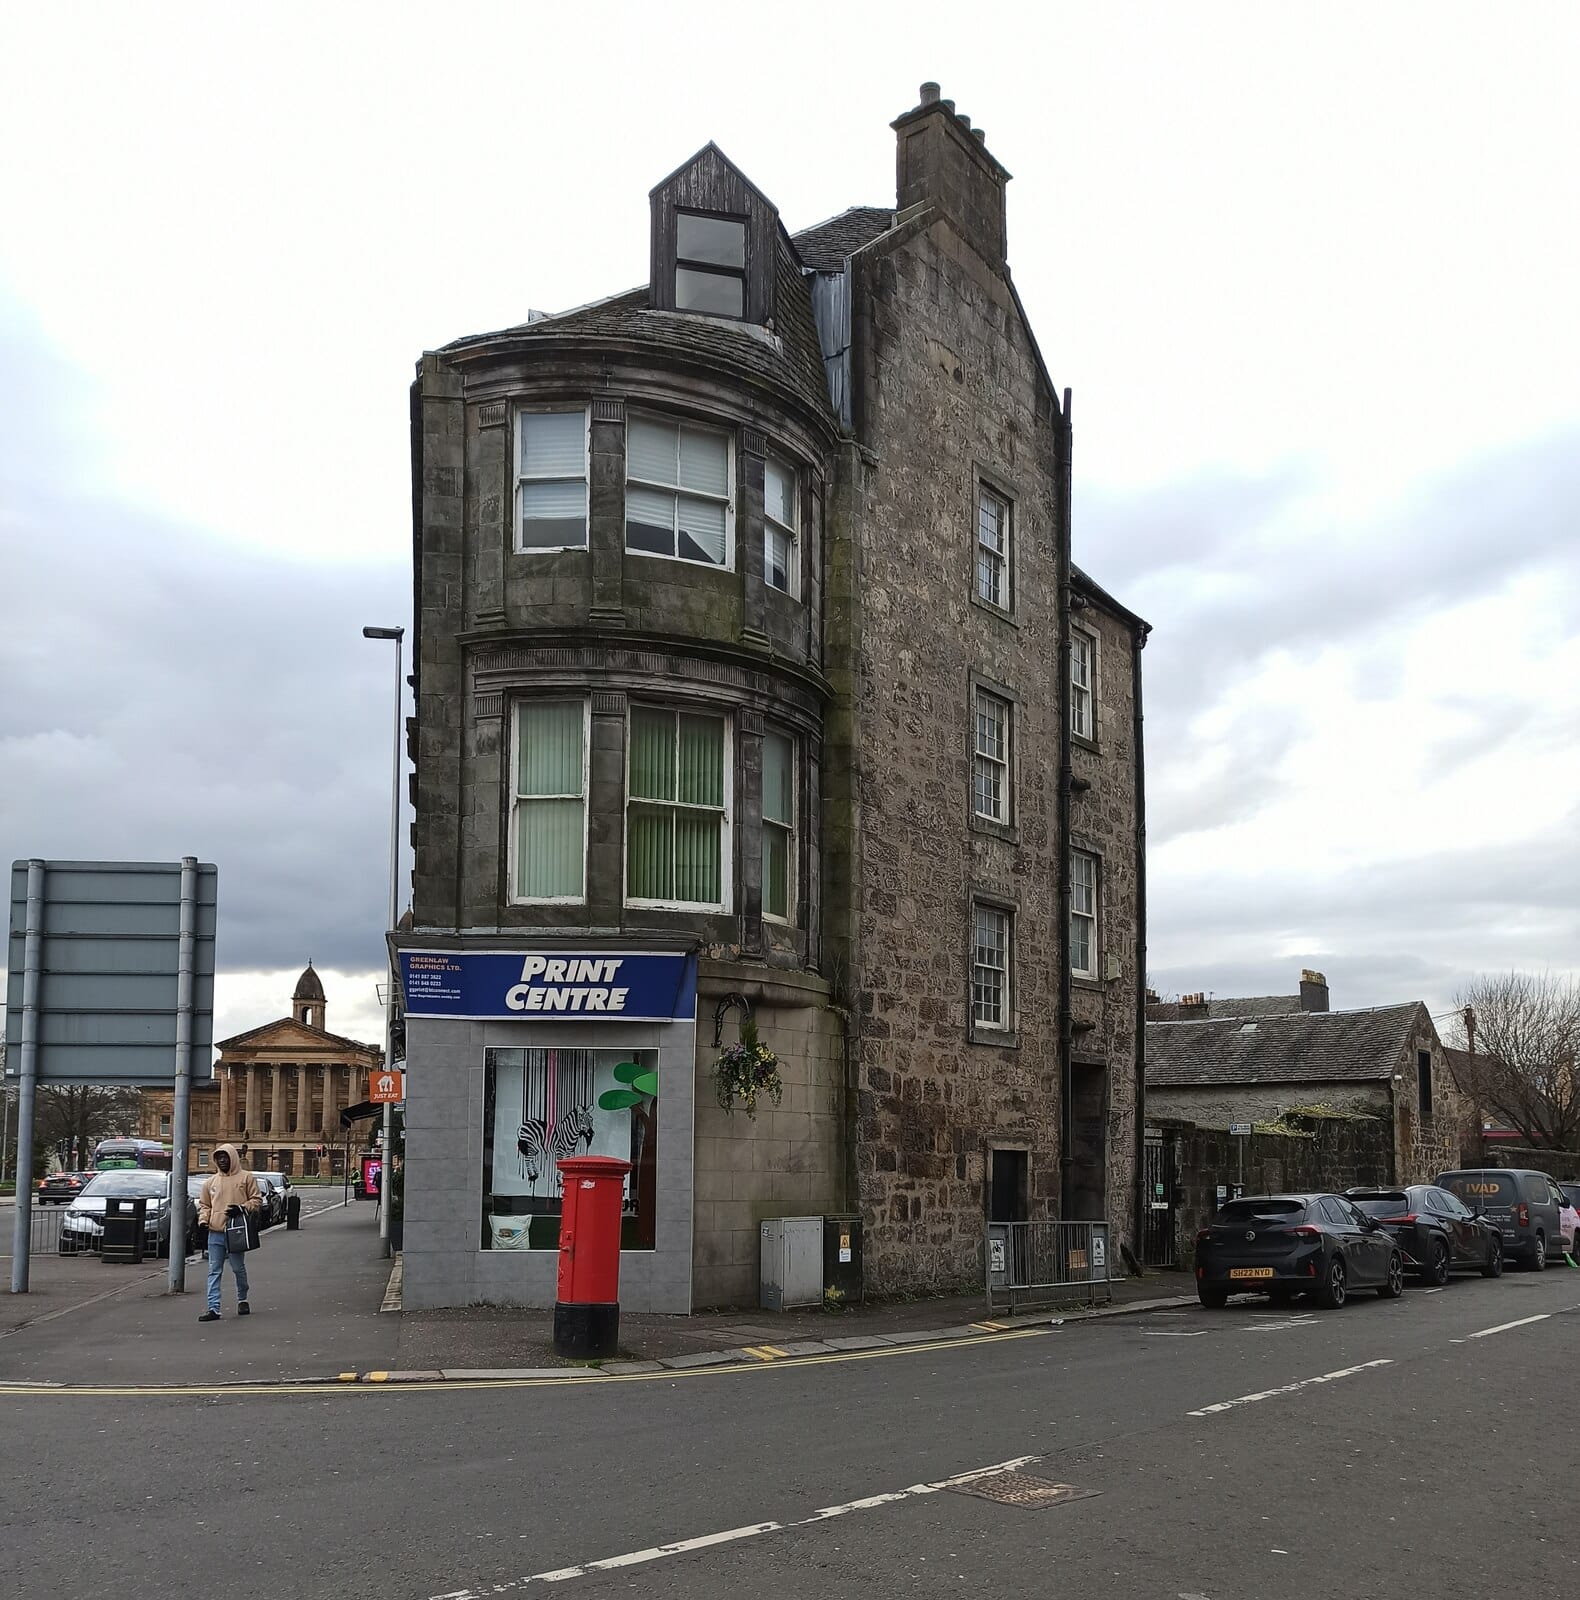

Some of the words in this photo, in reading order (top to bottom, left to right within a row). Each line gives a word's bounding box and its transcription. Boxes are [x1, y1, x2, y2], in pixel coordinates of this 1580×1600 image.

[520, 956, 624, 982] PRINT
[505, 984, 630, 1011] CENTRE
[1466, 1183, 1500, 1193] IVAD
